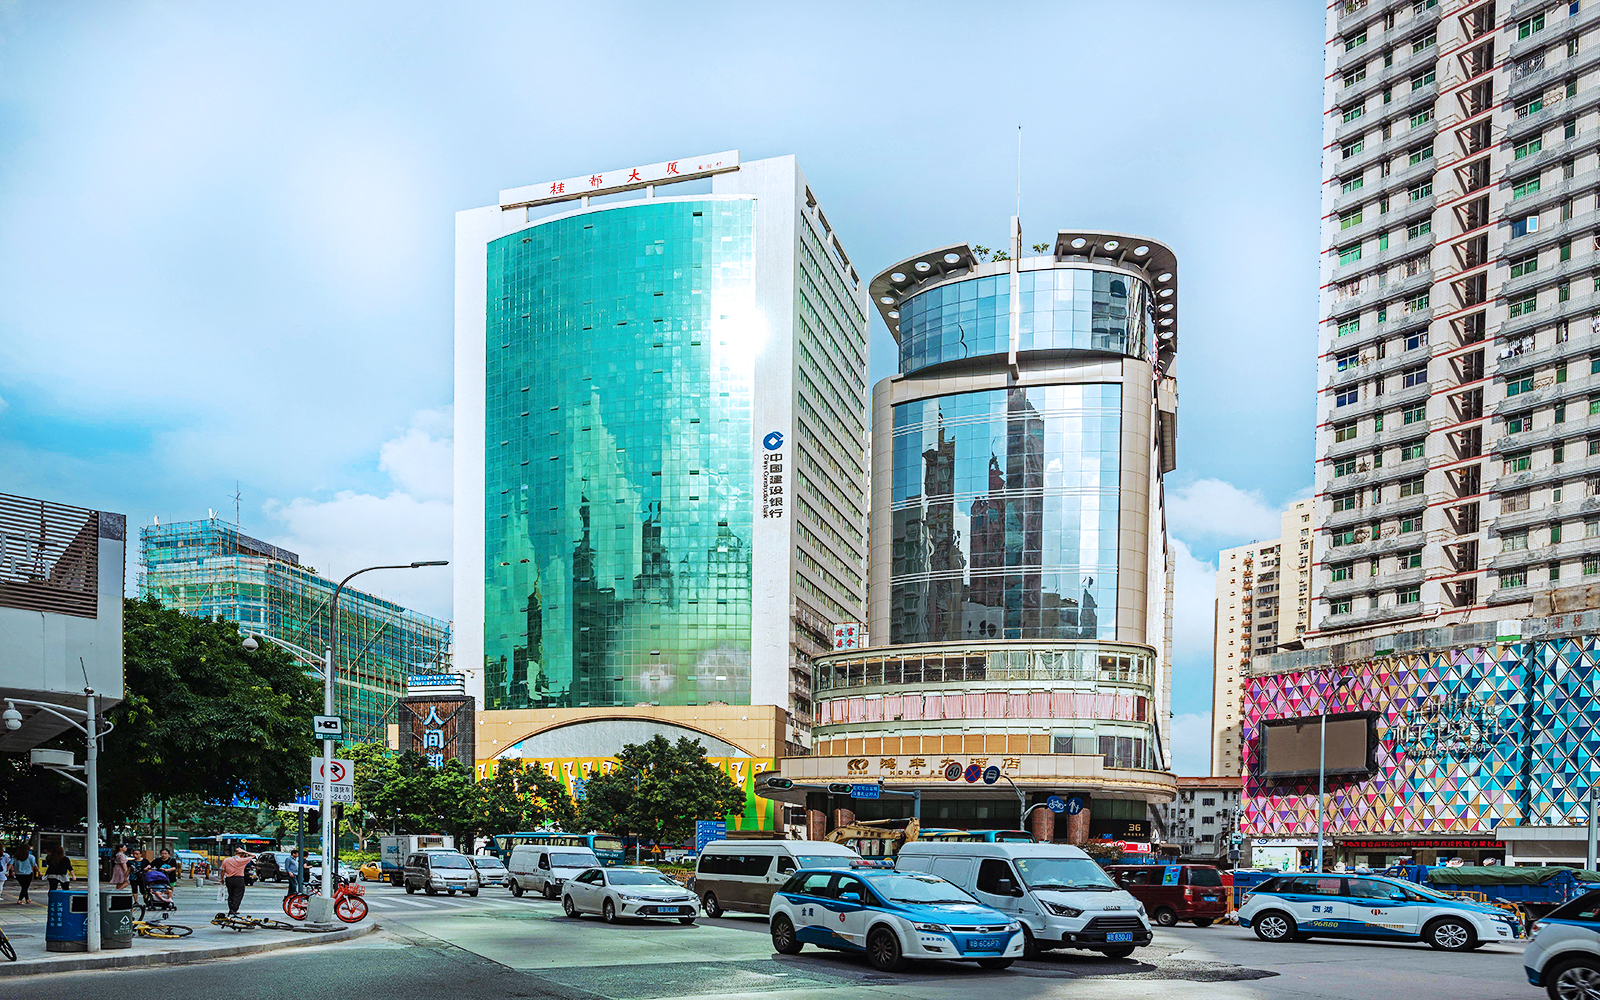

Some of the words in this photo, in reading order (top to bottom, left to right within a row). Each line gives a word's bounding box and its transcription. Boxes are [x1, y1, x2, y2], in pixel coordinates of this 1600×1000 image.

[769, 453, 783, 518] 中国建设银行
[880, 757, 1021, 770] 鸿丰大酒店
[948, 767, 960, 777] 60
[1128, 823, 1141, 831] 36
[1312, 905, 1333, 913] 西湖
